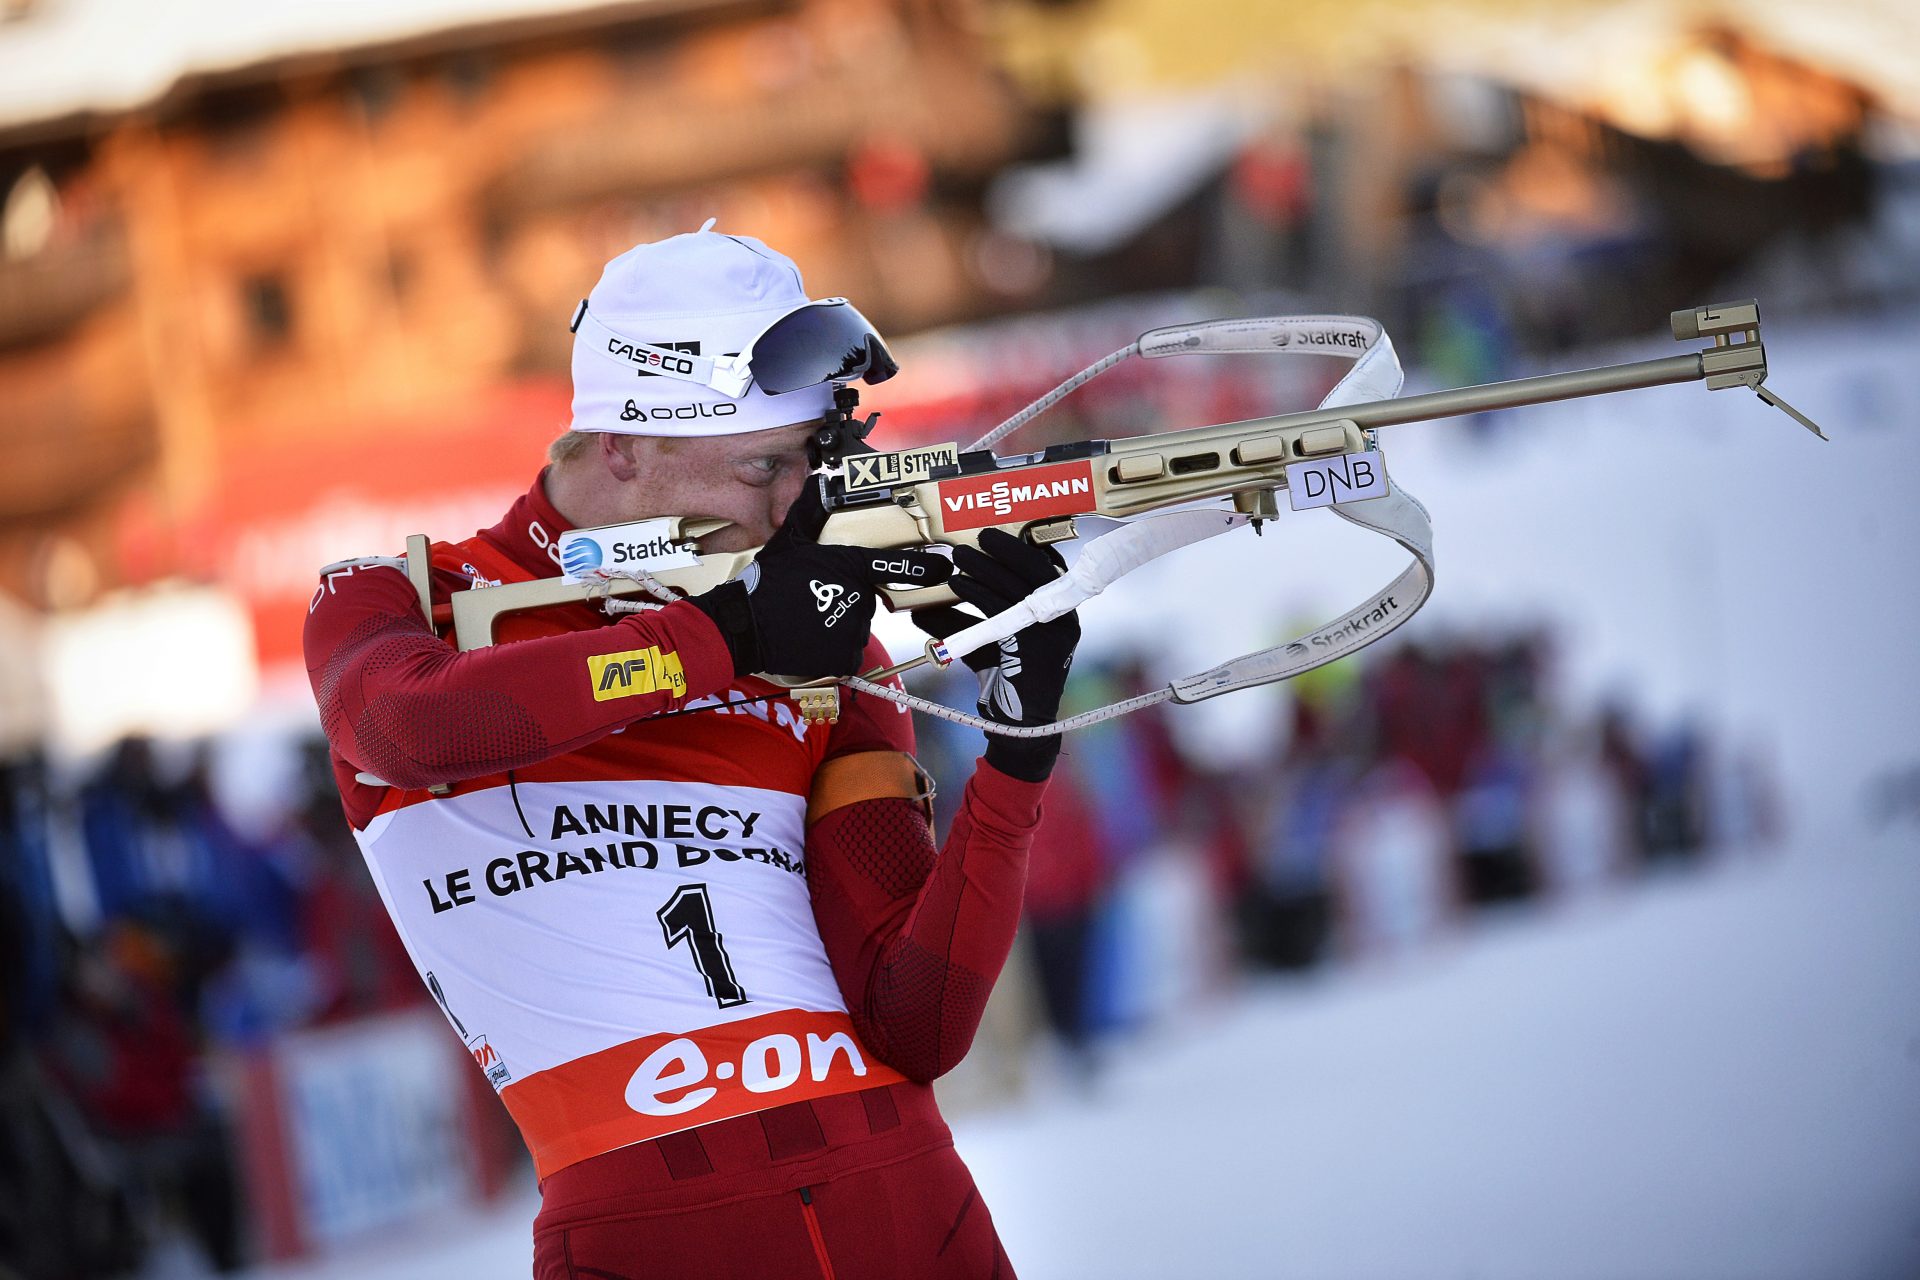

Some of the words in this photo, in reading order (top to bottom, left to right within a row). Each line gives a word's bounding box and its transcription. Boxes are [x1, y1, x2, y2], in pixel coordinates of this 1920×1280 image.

[1298, 330, 1369, 350] Statkraft
[651, 402, 737, 420] odlo
[850, 457, 899, 487] XL
[904, 450, 953, 474] STRYN
[1303, 455, 1375, 503] DNB
[944, 477, 1089, 515] VIESSMANN
[872, 559, 925, 576] odlo
[824, 591, 861, 628] odlo
[1311, 596, 1399, 647] Statkraft
[550, 804, 761, 841] ANNECY
[422, 868, 476, 914] LE
[485, 841, 659, 897] GRAND
[656, 882, 753, 1010] 1
